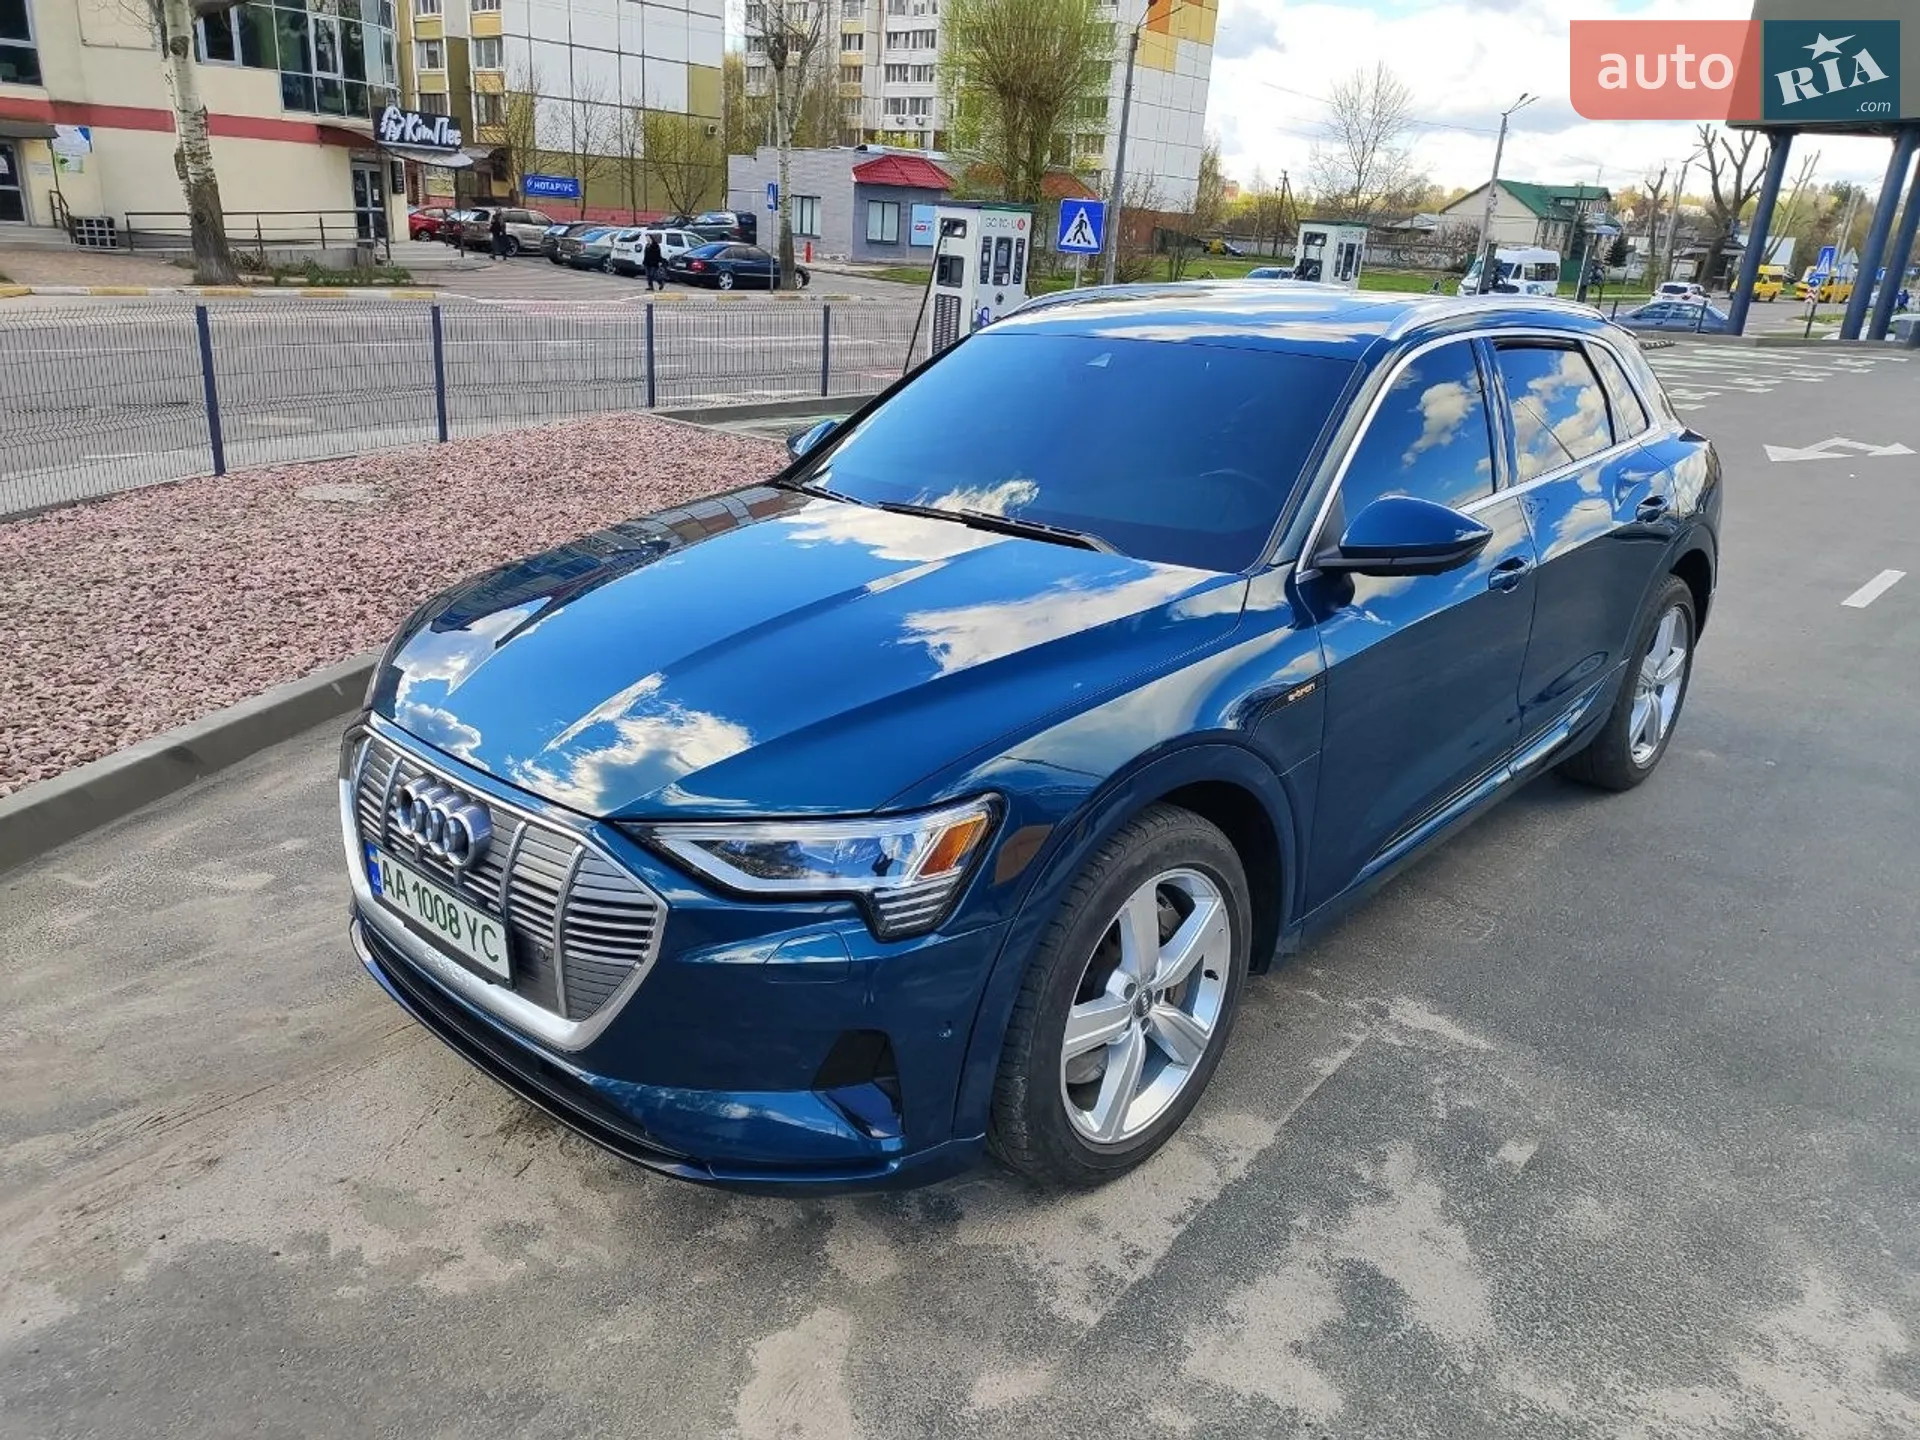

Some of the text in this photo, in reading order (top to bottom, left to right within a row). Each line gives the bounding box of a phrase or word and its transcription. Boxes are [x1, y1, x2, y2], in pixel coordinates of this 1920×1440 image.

[382, 859, 499, 963] AA 1008 YC
